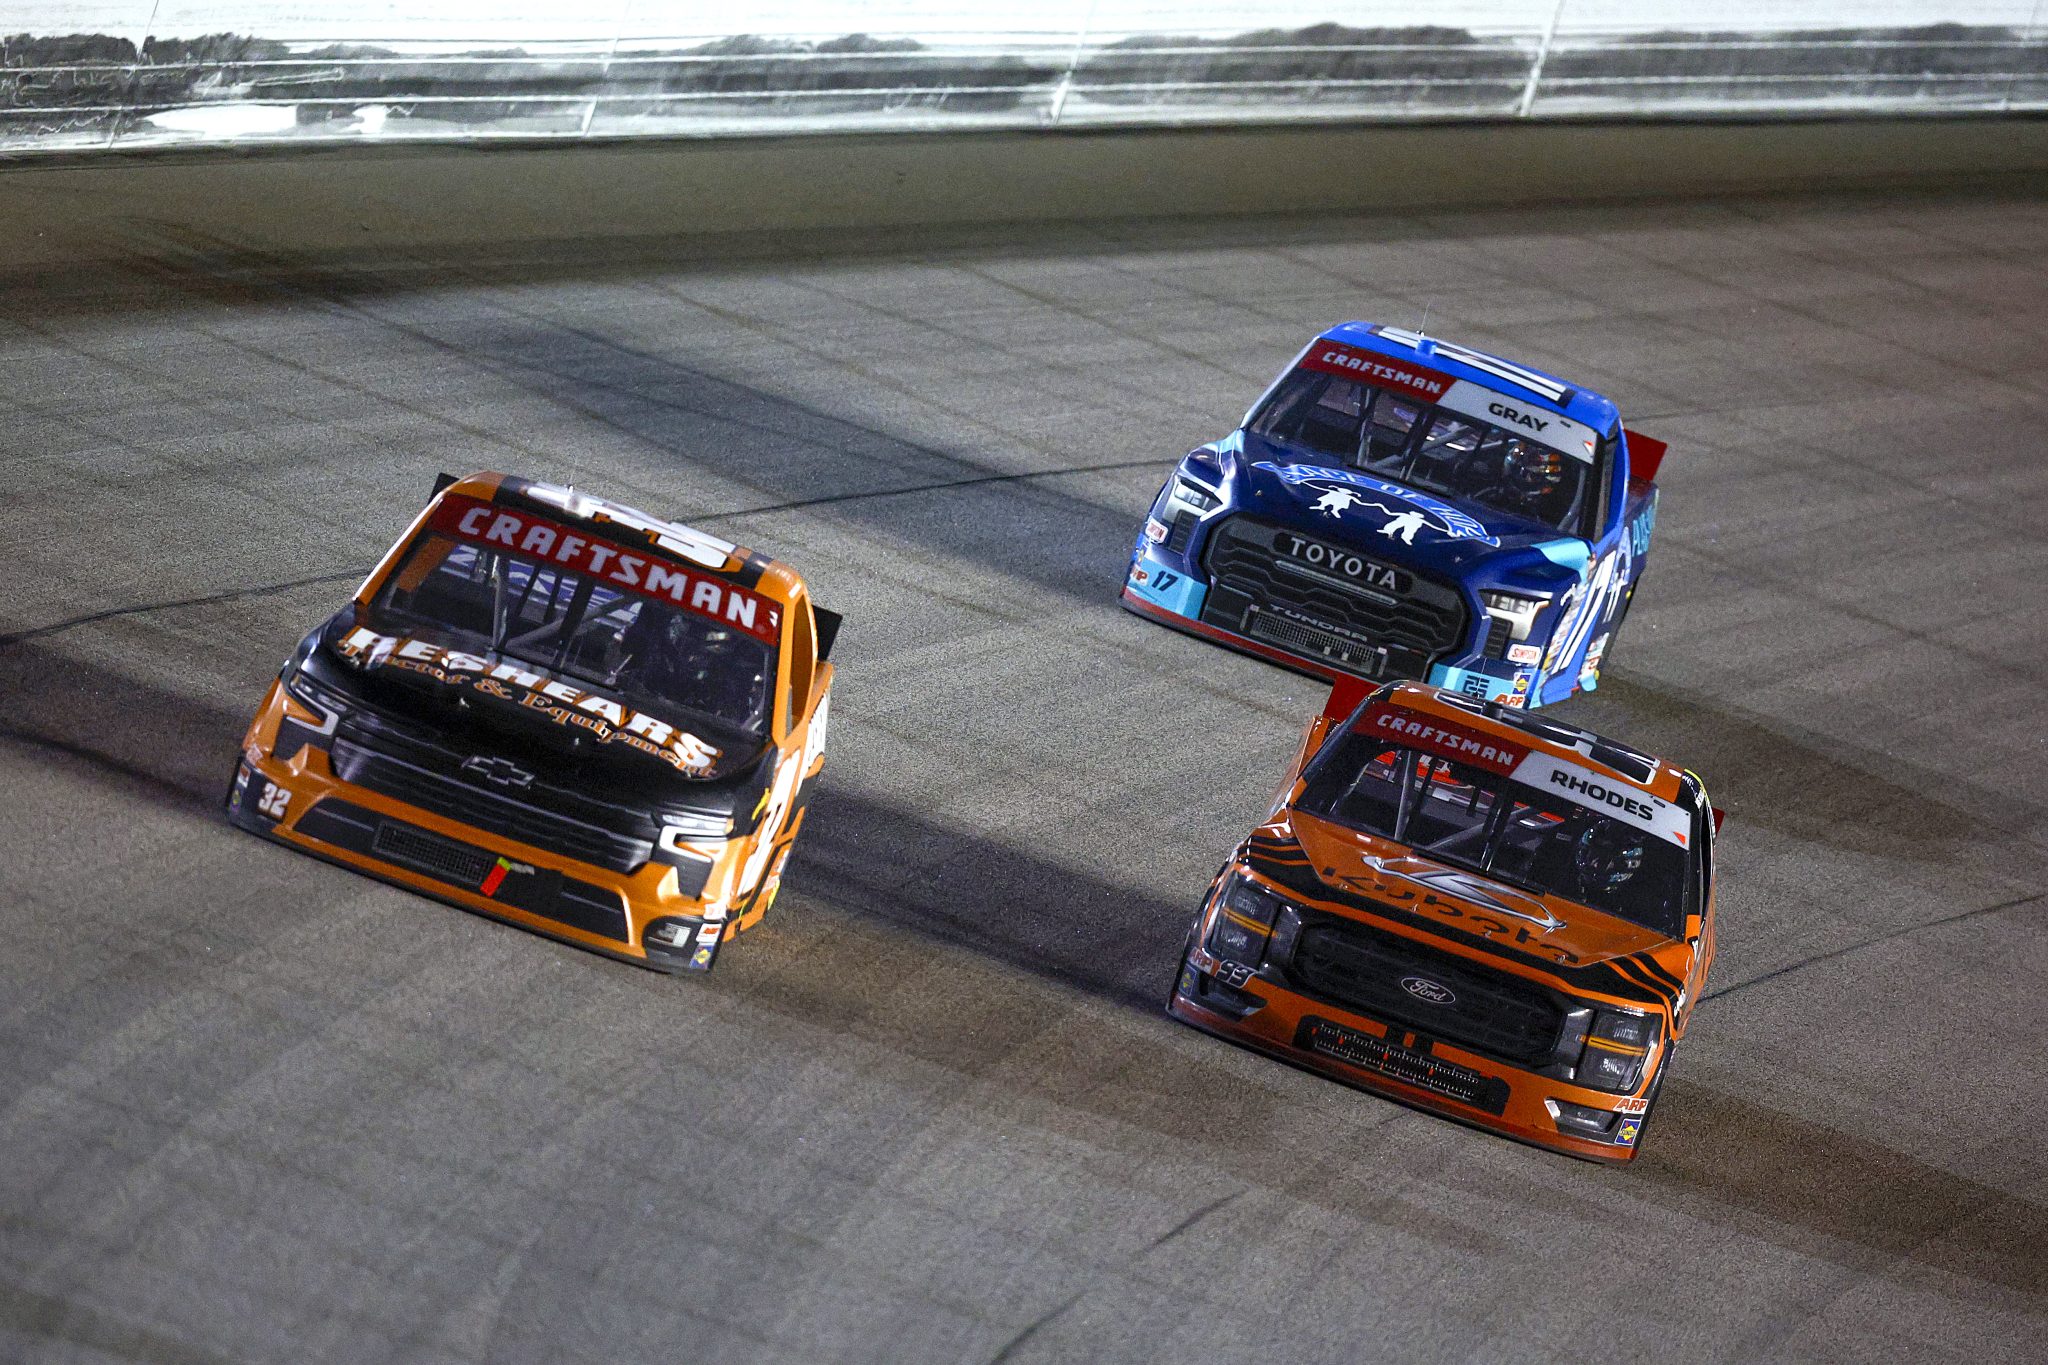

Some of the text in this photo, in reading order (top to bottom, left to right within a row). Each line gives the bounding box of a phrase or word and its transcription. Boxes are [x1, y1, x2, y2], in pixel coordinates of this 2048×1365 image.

[1322, 351, 1441, 393] CRAFTSMAN
[1488, 402, 1548, 432] GRAY
[458, 506, 757, 629] CRAFTSMAN
[1151, 570, 1178, 592] 17
[1290, 537, 1396, 590] TOYOTA
[1270, 603, 1368, 642] TUNDRA
[473, 678, 513, 700] &
[1377, 714, 1514, 766] CRAFTSMAN
[258, 782, 292, 817] 32
[1550, 769, 1654, 821] RHODES
[1410, 980, 1446, 1001] Ford
[1615, 1098, 1648, 1111] ARP
